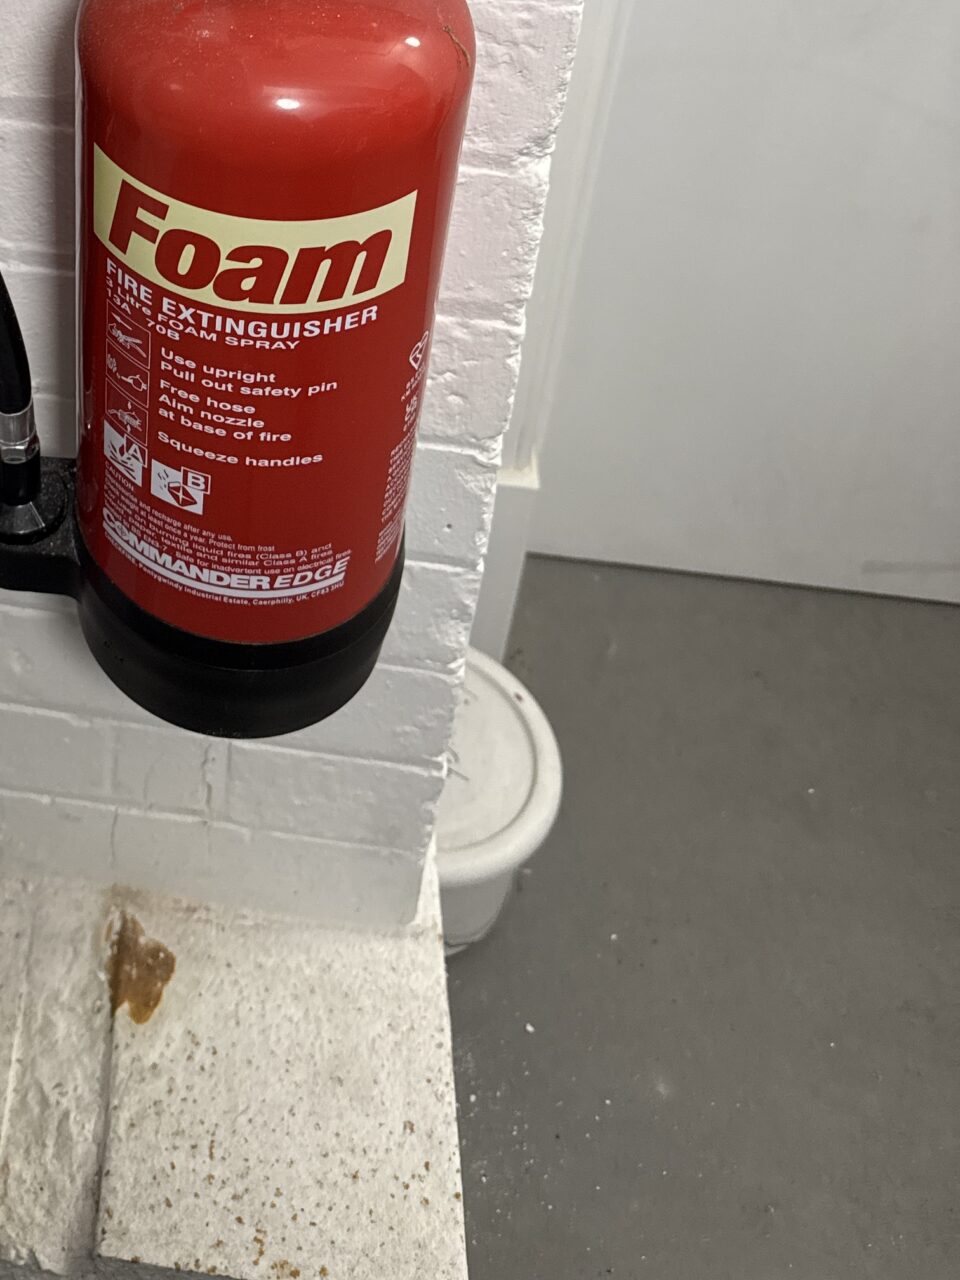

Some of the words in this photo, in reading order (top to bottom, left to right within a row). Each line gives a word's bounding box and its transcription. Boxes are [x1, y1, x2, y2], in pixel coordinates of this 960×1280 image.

[107, 177, 394, 306] Foam
[105, 256, 154, 306] FIRE
[161, 294, 380, 341] EXTINGUISHER
[106, 287, 133, 316] 13A
[145, 318, 182, 343] 70B
[116, 284, 153, 318] Litre
[157, 311, 218, 342] FOAM
[224, 335, 301, 351] SPRAY
[160, 346, 197, 371] Use
[202, 364, 277, 386] upright
[160, 360, 196, 384] Pull
[201, 378, 234, 394] out
[239, 384, 302, 399] safety
[307, 380, 339, 398] pin
[158, 393, 195, 417] Aim
[199, 407, 266, 429] nozzle
[159, 378, 201, 403] Free
[206, 395, 257, 415] hose
[158, 407, 175, 422] at
[180, 415, 227, 438] base
[233, 429, 254, 442] of
[258, 430, 293, 443] fire
[157, 430, 239, 465] Squeeze
[245, 452, 324, 468] handles
[187, 471, 206, 490] B
[149, 521, 190, 548] burning
[192, 542, 224, 557] liquid
[183, 522, 200, 534] after
[208, 538, 236, 550] Protect
[102, 506, 271, 590] COMMANDER
[273, 555, 351, 588] EDGE
[161, 535, 194, 555] textile
[221, 556, 260, 567] similar
[263, 558, 296, 567] Class
[211, 560, 261, 575] inadvertent
